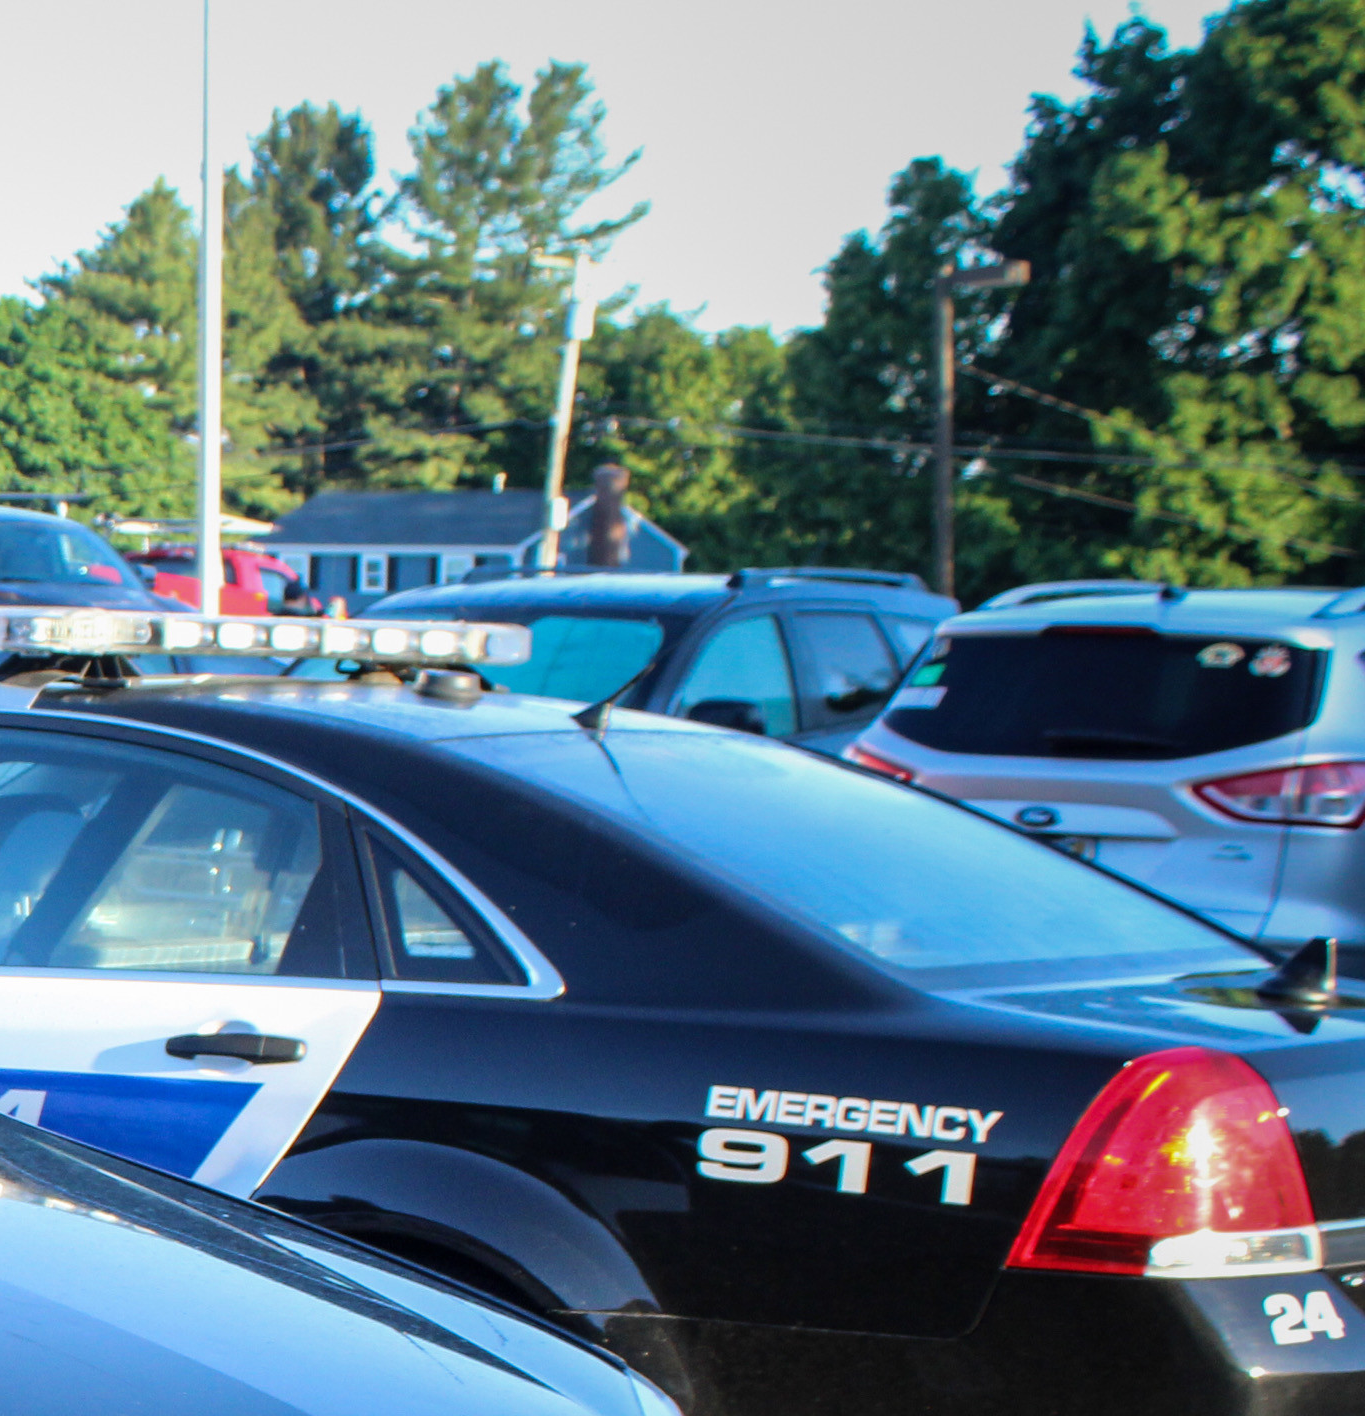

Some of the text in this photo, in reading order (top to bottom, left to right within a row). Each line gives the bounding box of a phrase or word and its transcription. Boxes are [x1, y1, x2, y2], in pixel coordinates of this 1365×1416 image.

[704, 1085, 1004, 1143] EMERGENCY
[695, 1128, 977, 1206] 911
[1262, 1291, 1347, 1346] 24
